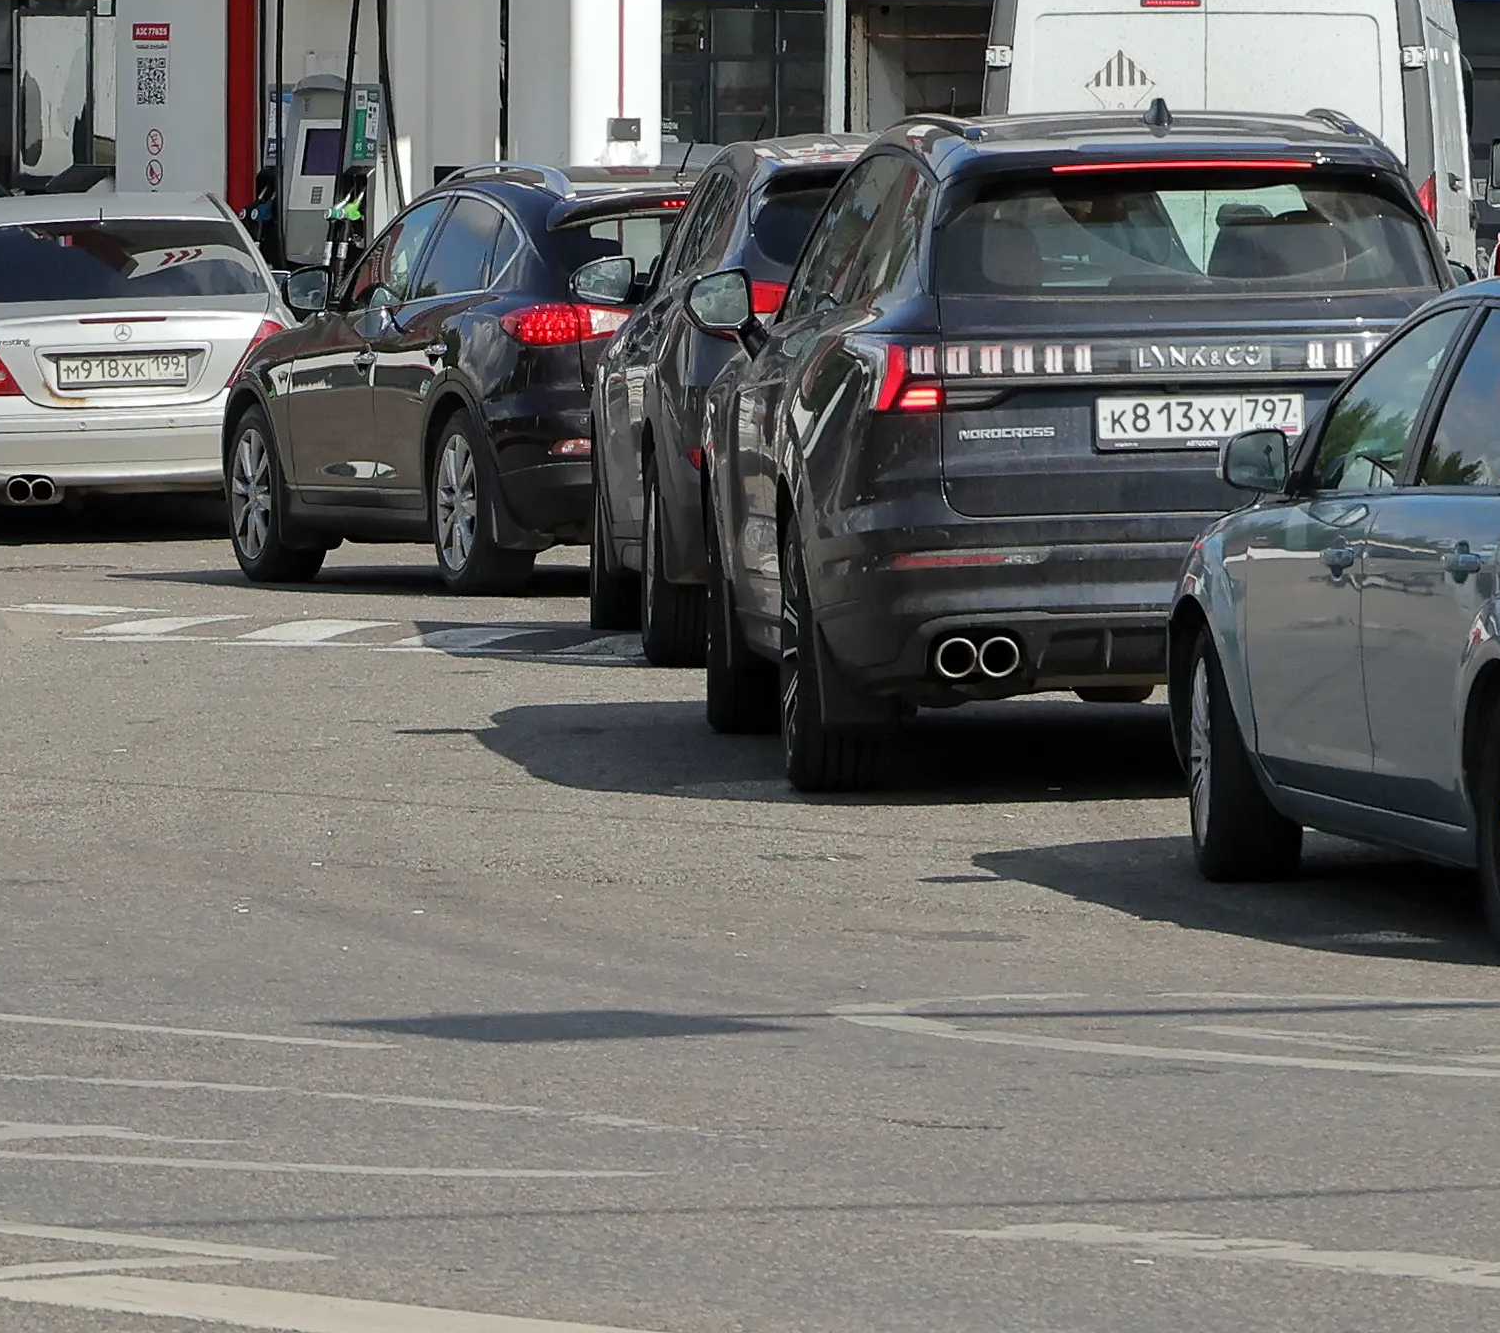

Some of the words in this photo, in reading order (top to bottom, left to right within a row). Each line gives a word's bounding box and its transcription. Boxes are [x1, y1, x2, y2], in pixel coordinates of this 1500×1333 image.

[65, 359, 146, 380] М918ХК
[151, 355, 180, 371] 199
[1136, 345, 1263, 368] LYNK&CO
[1110, 401, 1237, 434] К813ХУ
[1245, 398, 1293, 422] 797
